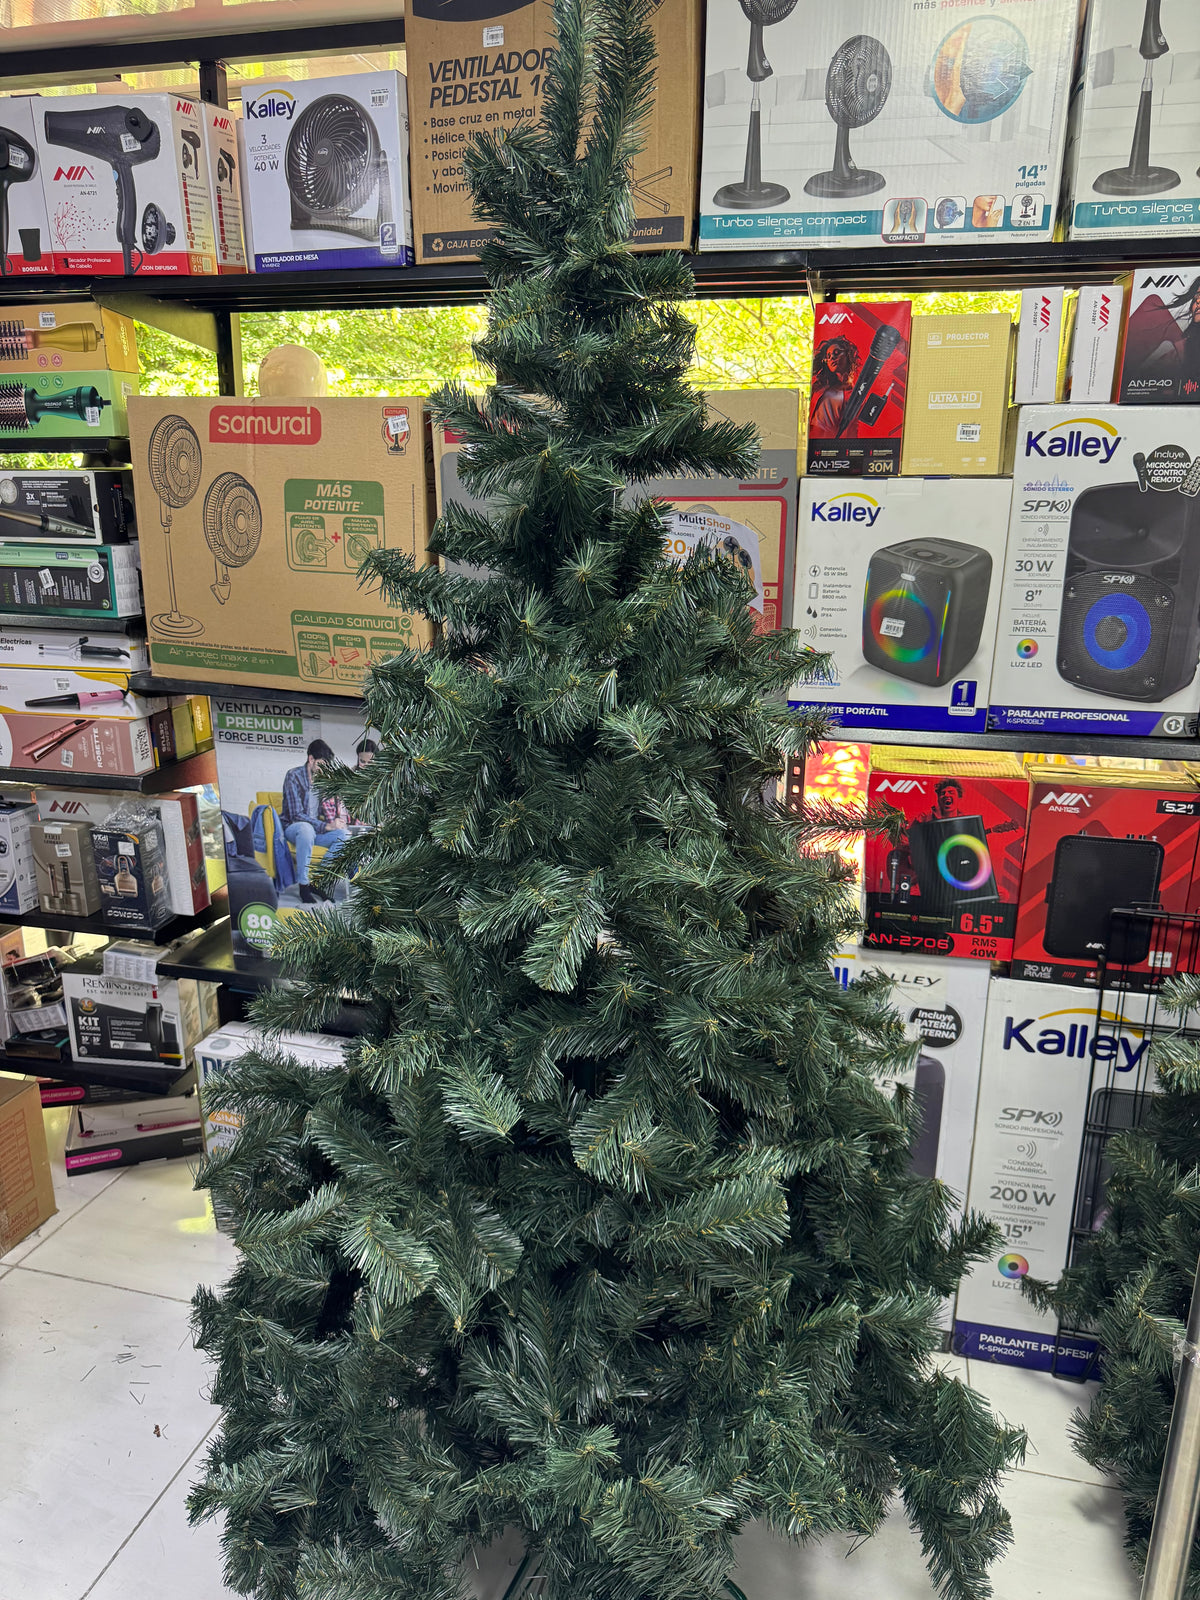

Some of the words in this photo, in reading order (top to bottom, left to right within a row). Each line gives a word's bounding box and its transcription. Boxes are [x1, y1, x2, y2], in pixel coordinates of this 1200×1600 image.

[429, 48, 553, 83] VENTILADOR
[429, 75, 522, 108] PEDESTAL
[246, 99, 296, 120] Kalley
[430, 117, 456, 128] Base
[459, 114, 482, 125] cruz
[485, 112, 499, 122] en
[503, 106, 536, 120] metal
[261, 134, 267, 144] 3
[431, 131, 465, 145] Hélice
[249, 143, 281, 152] VELOCIDADES
[254, 161, 267, 172] 40
[269, 160, 279, 170] W
[432, 169, 439, 180] y
[441, 165, 464, 177] aba
[53, 166, 94, 181] NIA
[1015, 180, 1046, 188] pulgadas
[1091, 204, 1137, 216] Turbo
[1142, 202, 1193, 214] silence
[712, 217, 753, 228] Turbo
[757, 215, 803, 227] silence
[806, 213, 867, 226] compact
[1160, 214, 1169, 223] 2
[1188, 213, 1194, 222] 1
[383, 225, 393, 241] 2
[632, 226, 663, 237] unidad
[773, 228, 782, 236] 2
[888, 234, 919, 242] COMPACTO
[446, 240, 468, 249] CAJA
[261, 256, 295, 264] VENTILADOR
[1140, 274, 1185, 288] NIA
[818, 313, 853, 325] NIA
[946, 332, 989, 340] PROJECTOR
[1127, 380, 1173, 388] AN-P40
[930, 393, 958, 403] ULTRA
[961, 393, 977, 402] HD
[217, 411, 313, 435] samurai
[1025, 431, 1121, 464] Kalley
[1154, 451, 1185, 460] Incluye
[810, 460, 851, 469] AN-152
[868, 462, 893, 473] 30M
[1146, 461, 1191, 469] MICRÓFONO
[26, 492, 35, 500] 3x
[316, 481, 353, 498] MÁS
[811, 501, 881, 527] Kalley
[678, 513, 731, 531] MultiShop
[1014, 560, 1034, 572] 30
[1036, 560, 1054, 572] W
[294, 614, 344, 626] CALIDAD
[346, 616, 397, 630] samurai
[169, 647, 184, 656] Air
[186, 650, 219, 660] protec
[220, 654, 249, 663] maxx
[957, 682, 969, 702] 1
[216, 701, 302, 717] VENTILADOR
[846, 706, 889, 716] PORTÁTIL
[1007, 709, 1058, 720] PARLANTE
[1060, 711, 1130, 722] PROFESIONAL
[225, 715, 295, 732] PREMIUM
[158, 723, 166, 752] CETUS
[218, 731, 254, 742] FORCE
[256, 734, 285, 745] PLUS
[92, 727, 103, 768] ROSETTE
[875, 779, 926, 794] NIA
[1040, 791, 1092, 808] NIA
[49, 799, 90, 816] NIA
[247, 913, 273, 930] 80
[868, 932, 949, 950] AN-2706
[972, 937, 998, 948] RMS
[970, 948, 997, 959] 40W
[1023, 964, 1039, 973] 30
[1041, 965, 1053, 973] W
[1023, 970, 1051, 980] RMS
[860, 969, 942, 988] KLLEY
[78, 1015, 100, 1027] KIT
[917, 1009, 955, 1021] Incluye
[914, 1018, 957, 1031] BATERÍA
[918, 1028, 956, 1040] NTERNA
[1003, 1016, 1151, 1073] Kalley
[994, 1122, 1020, 1130] SONIDO
[1020, 1125, 1064, 1136] PROFESIONAL
[1002, 1164, 1048, 1175] INALÁMBRICA
[1007, 1158, 1043, 1168] CONEXIÓN
[997, 1179, 1031, 1189] POTENCIA
[989, 1185, 1028, 1203] 200
[1032, 1190, 1056, 1207] W
[1017, 1205, 1037, 1213] PMPO
[992, 1215, 1019, 1225] TAMAÑO
[1020, 1217, 1045, 1227] WOOFER
[991, 1280, 1012, 1290] LUZ
[979, 1333, 1039, 1351] PARLANTE
[978, 1343, 1025, 1358] K-SPK200X
